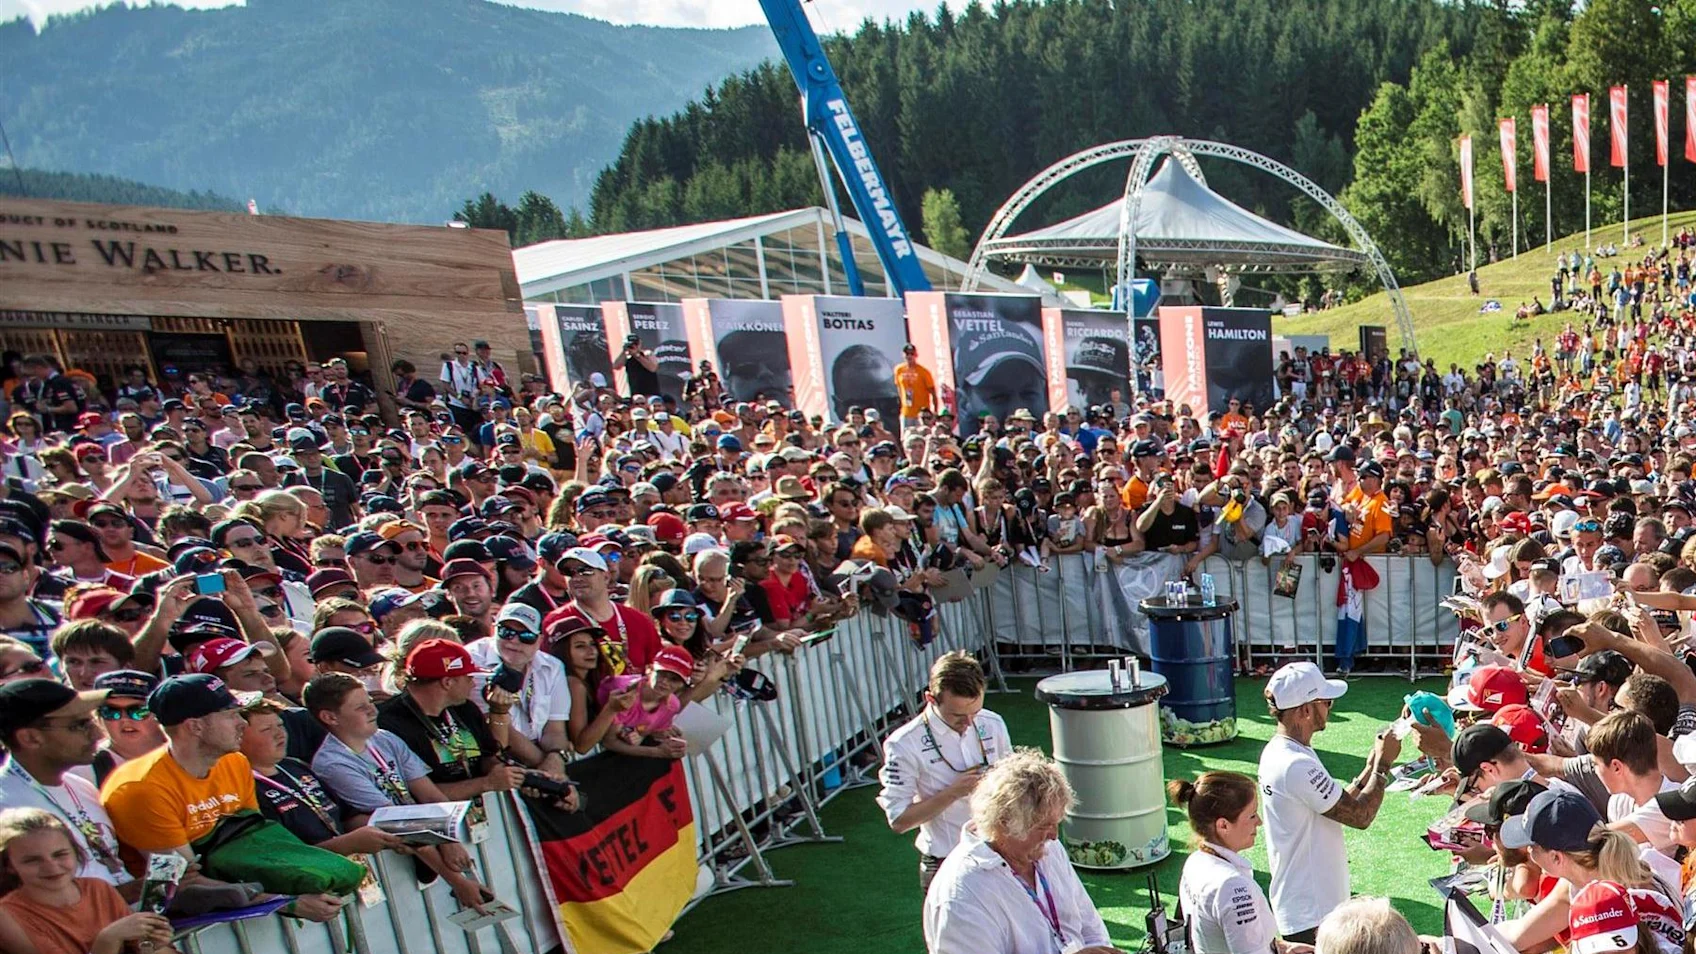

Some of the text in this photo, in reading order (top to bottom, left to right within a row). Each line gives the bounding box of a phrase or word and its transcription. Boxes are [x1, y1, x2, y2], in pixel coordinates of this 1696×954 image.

[826, 99, 912, 259] FELBERMAYR
[54, 217, 76, 228] OF
[87, 220, 178, 234] SCOTLAND
[563, 321, 599, 332] SAINZ
[634, 319, 670, 331] PEREZ
[823, 318, 875, 331] BOTTAS
[953, 319, 1005, 333] VETTEL
[1066, 327, 1124, 339] RICCIARDO
[1208, 328, 1267, 341] HAMILTON
[1578, 907, 1624, 924] Santander
[1611, 934, 1628, 948] 5
